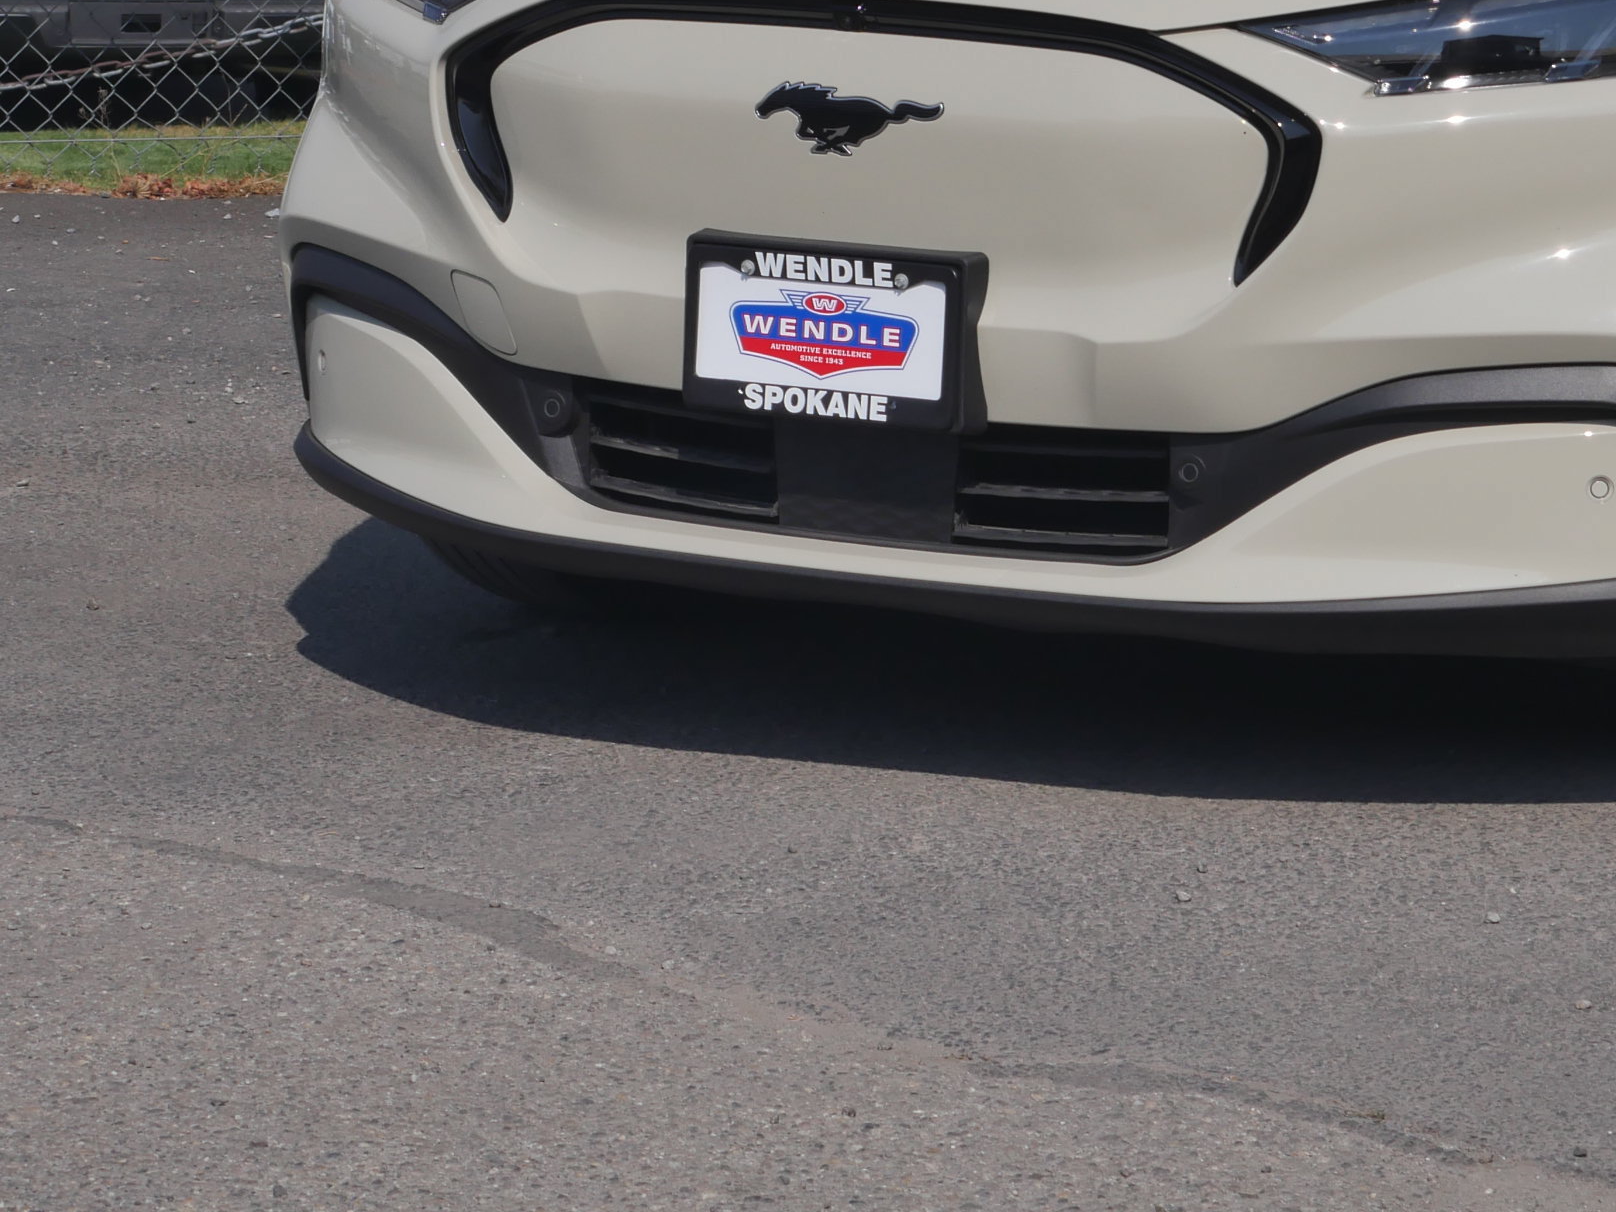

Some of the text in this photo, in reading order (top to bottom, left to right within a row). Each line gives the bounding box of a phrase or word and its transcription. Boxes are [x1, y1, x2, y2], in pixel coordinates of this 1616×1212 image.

[754, 251, 895, 288] WENDLE
[743, 314, 900, 348] WENDLE
[770, 342, 872, 359] AUTOMOTIVE EXCELLENCE
[799, 354, 844, 366] SINCE 1943
[744, 383, 888, 422] SPOKANE
